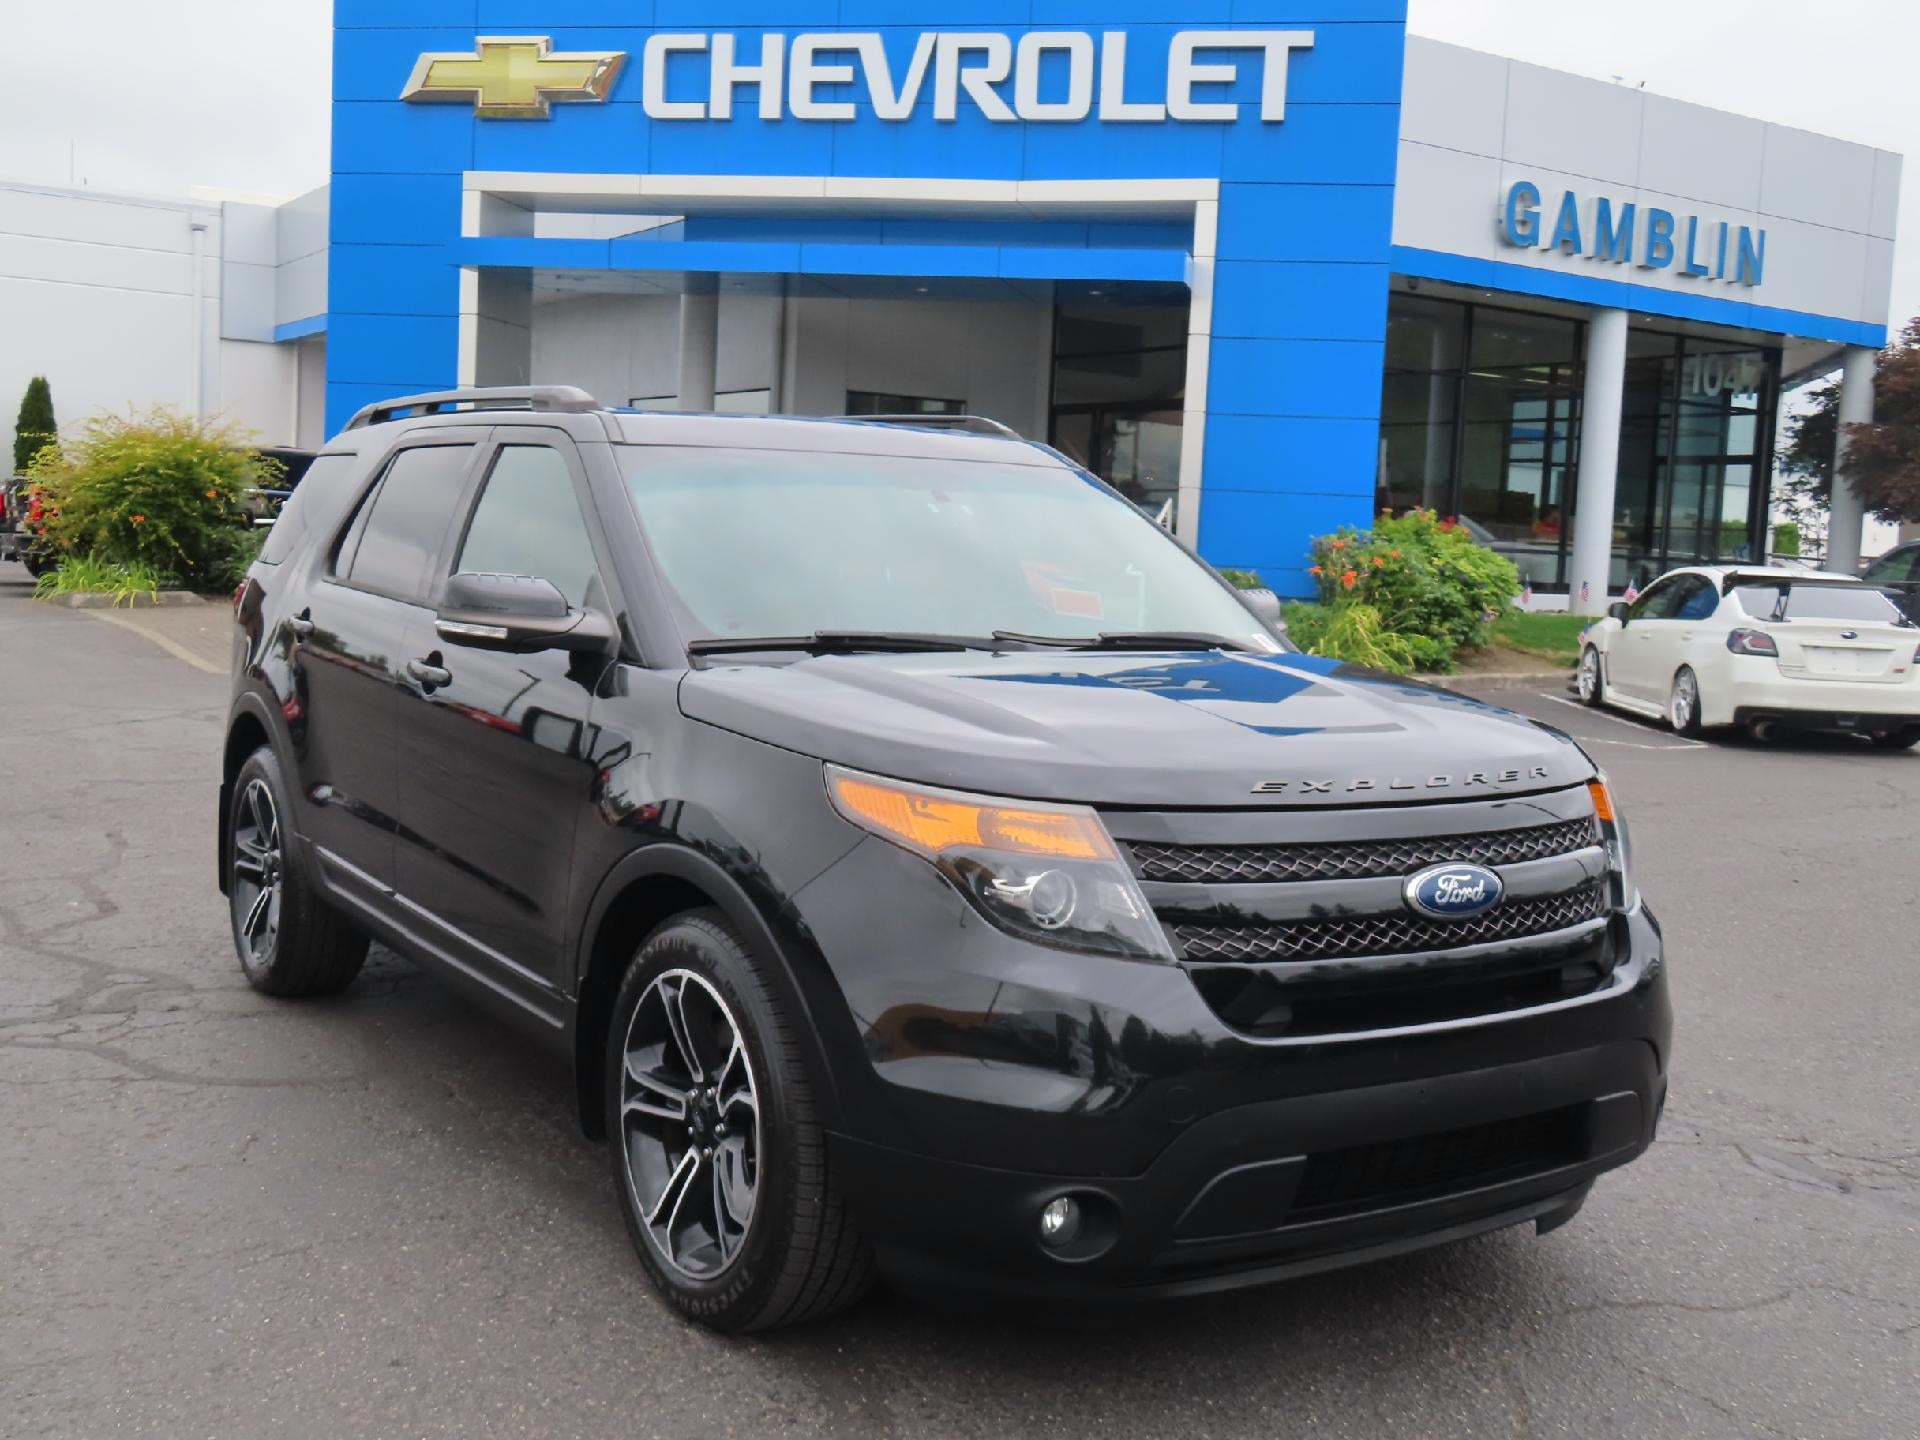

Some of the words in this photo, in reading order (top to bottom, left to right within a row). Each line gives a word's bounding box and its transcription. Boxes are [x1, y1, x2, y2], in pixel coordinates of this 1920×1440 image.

[643, 30, 1315, 122] CHEVROLET
[1502, 180, 1766, 286] GAMBLIN
[1250, 766, 1548, 793] EXPLORER
[1434, 874, 1486, 904] Ford
